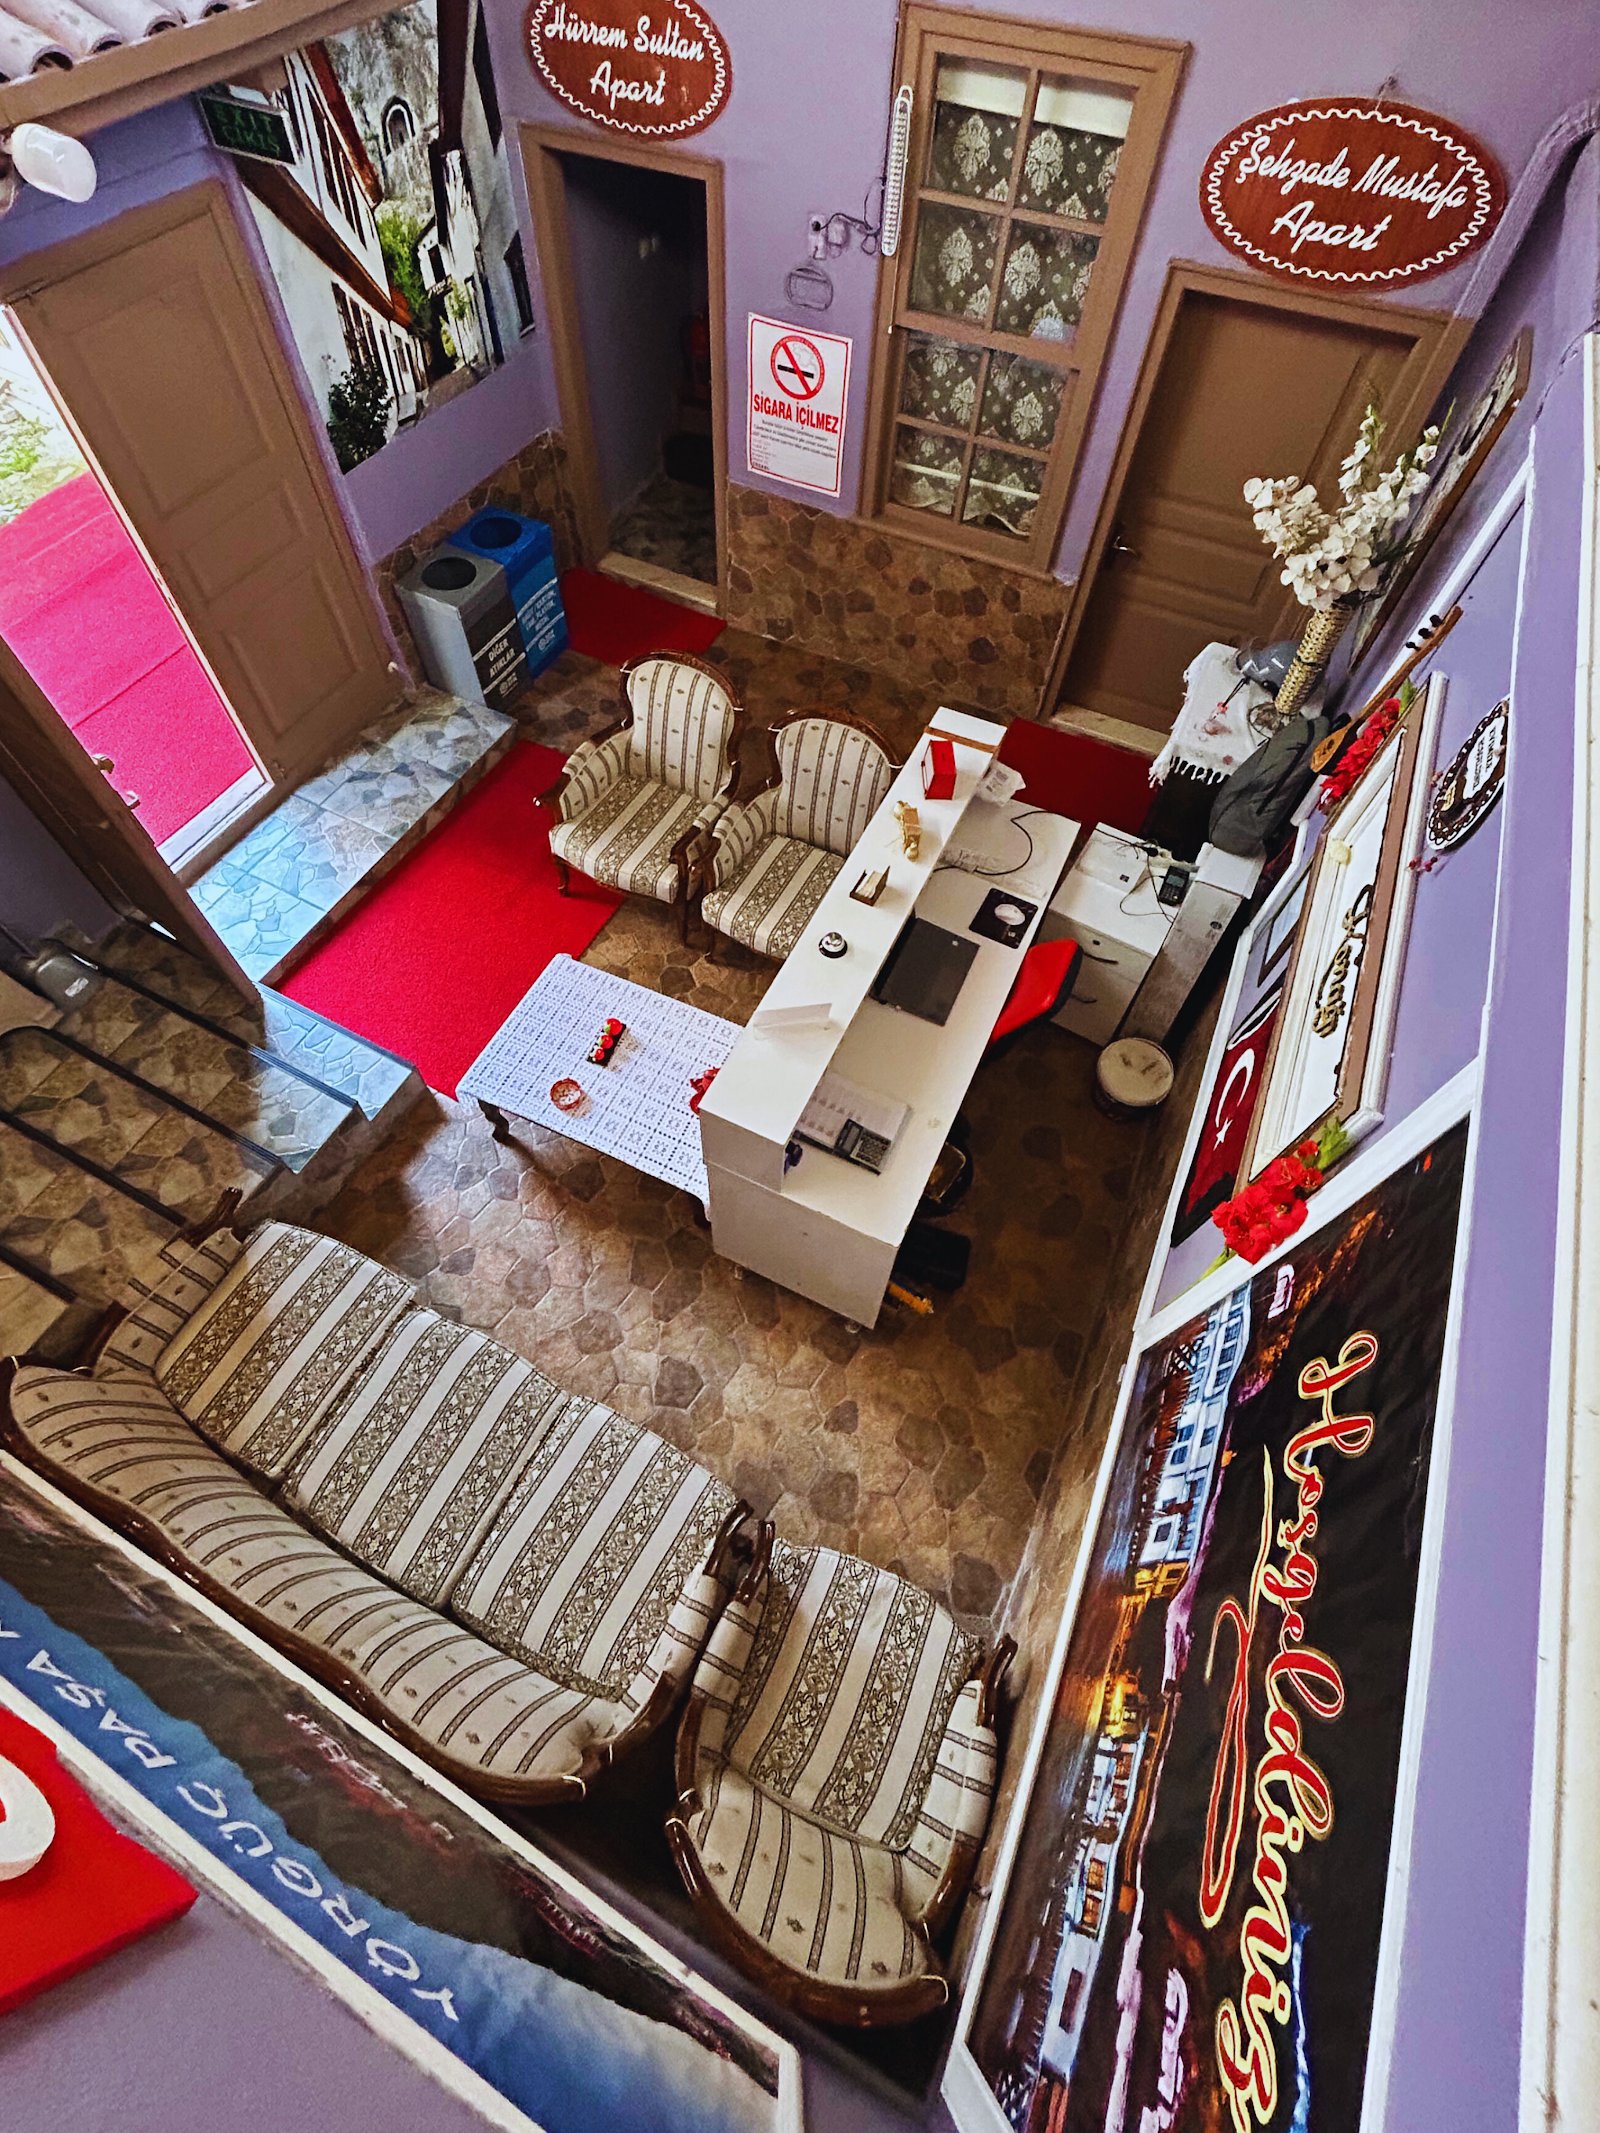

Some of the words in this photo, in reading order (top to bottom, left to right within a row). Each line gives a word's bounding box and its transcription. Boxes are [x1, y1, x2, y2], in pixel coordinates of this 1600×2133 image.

[544, 2, 629, 49] Hürrem
[633, 15, 705, 61] Sultan
[590, 60, 666, 110] Apart
[1235, 135, 1352, 195] Şehzade
[1351, 153, 1469, 220] Mustafa
[1270, 200, 1392, 254] Apart
[753, 391, 793, 421] SİGARA
[796, 401, 840, 434] İÇİLMEZ
[26, 1649, 178, 1769] PAŞA
